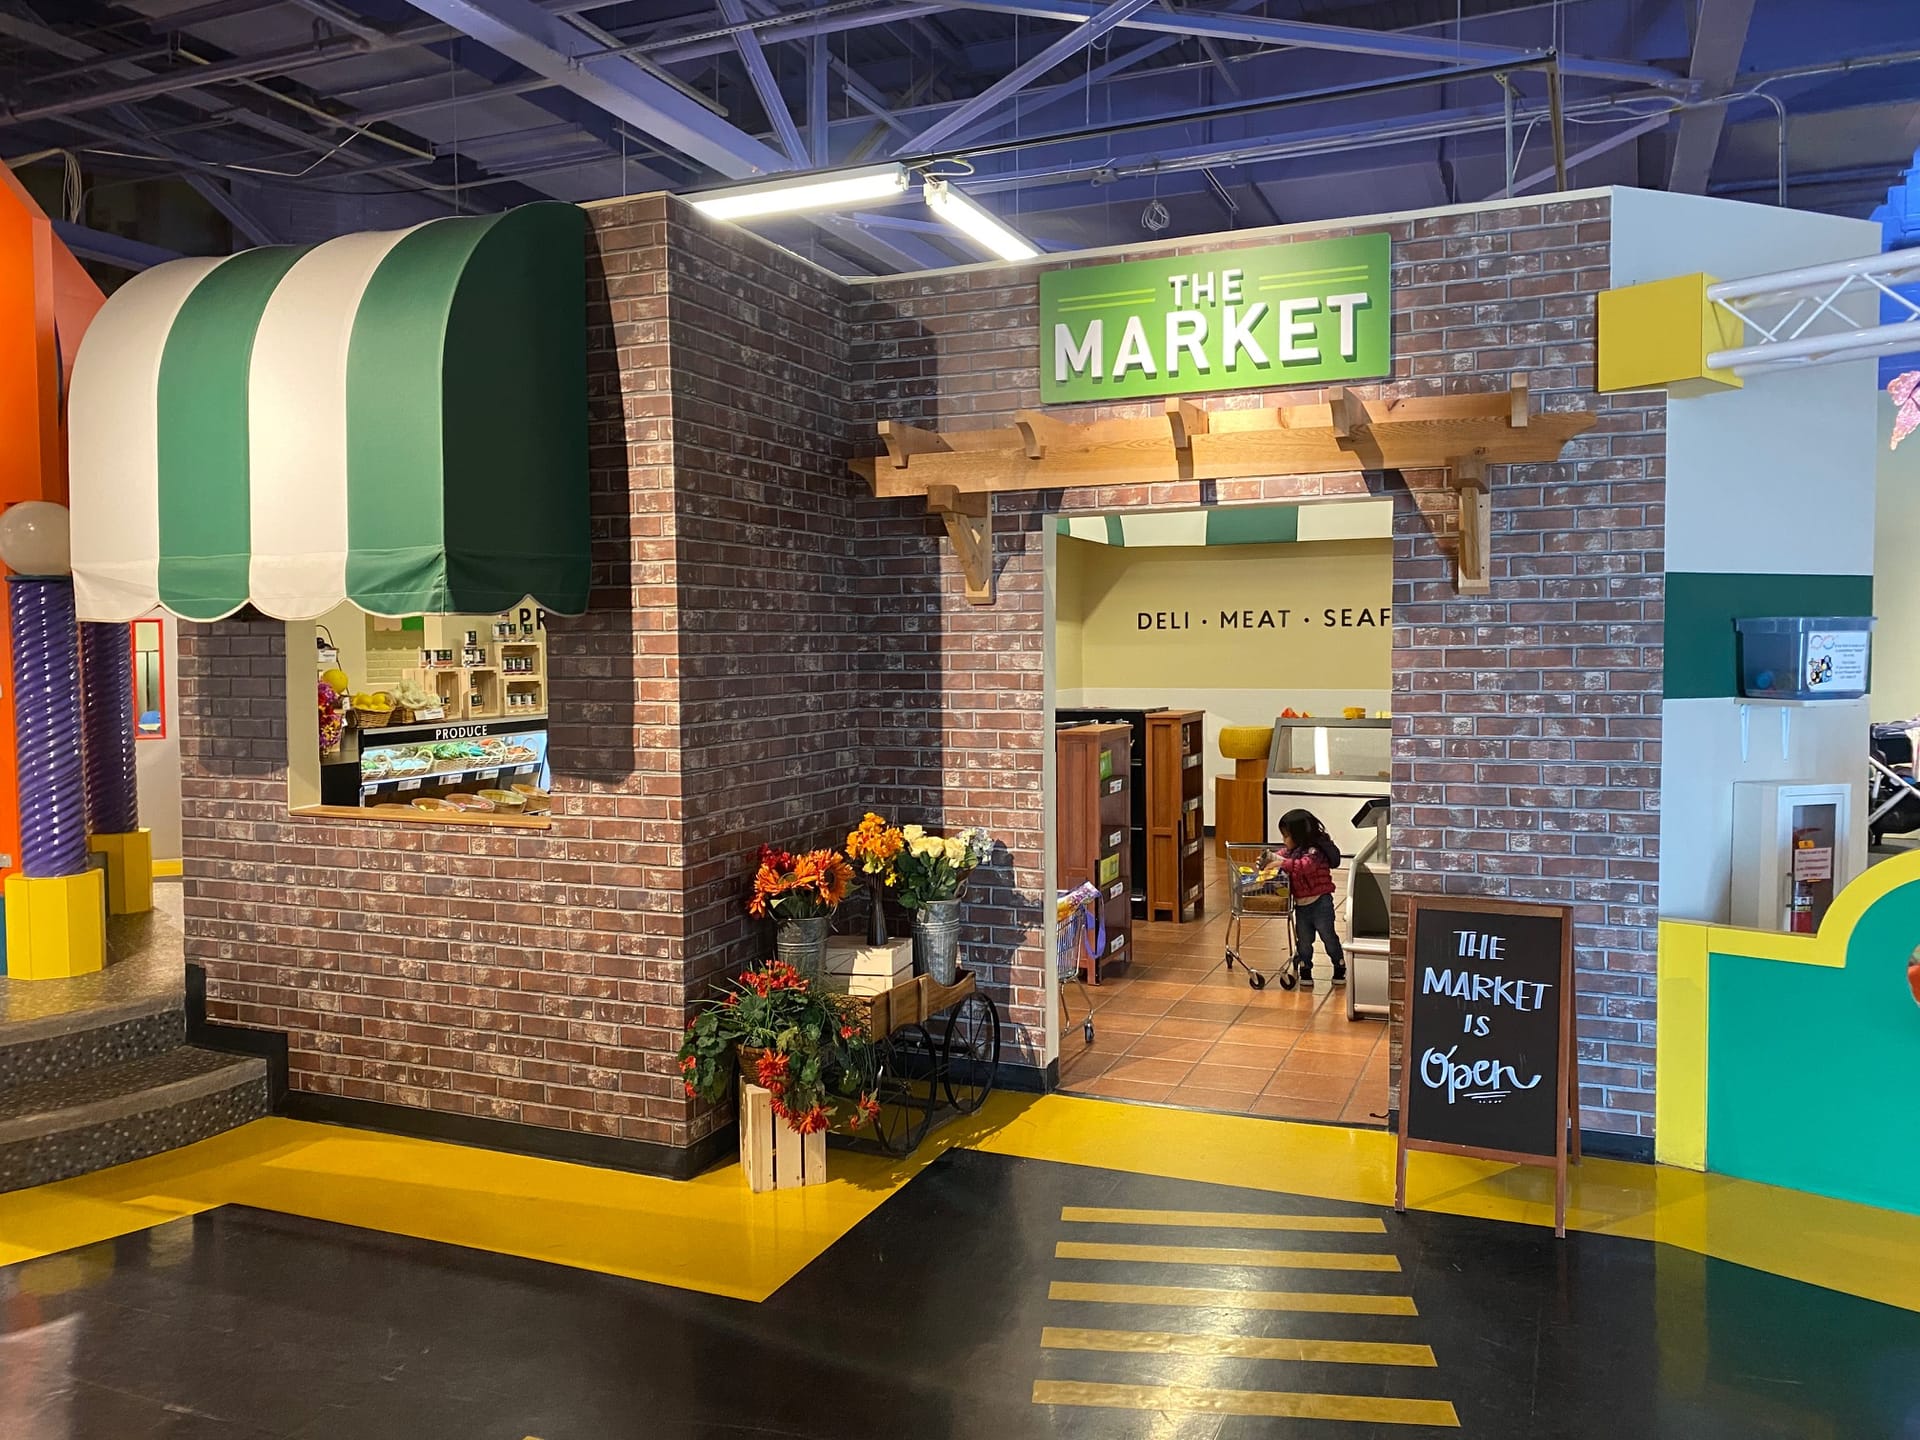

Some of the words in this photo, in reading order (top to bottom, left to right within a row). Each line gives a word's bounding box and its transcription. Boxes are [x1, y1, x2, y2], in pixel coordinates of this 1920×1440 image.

[1168, 268, 1243, 308] THE
[1055, 292, 1370, 383] MARKET
[1137, 610, 1189, 631] DELI
[1220, 609, 1291, 630] MEAT
[1323, 607, 1391, 627] SEAF
[435, 724, 488, 741] PRODUCE
[1453, 930, 1506, 960] THE
[1422, 966, 1553, 1012] MARKET
[1463, 1014, 1491, 1037] IS
[1420, 1045, 1542, 1104] Open
